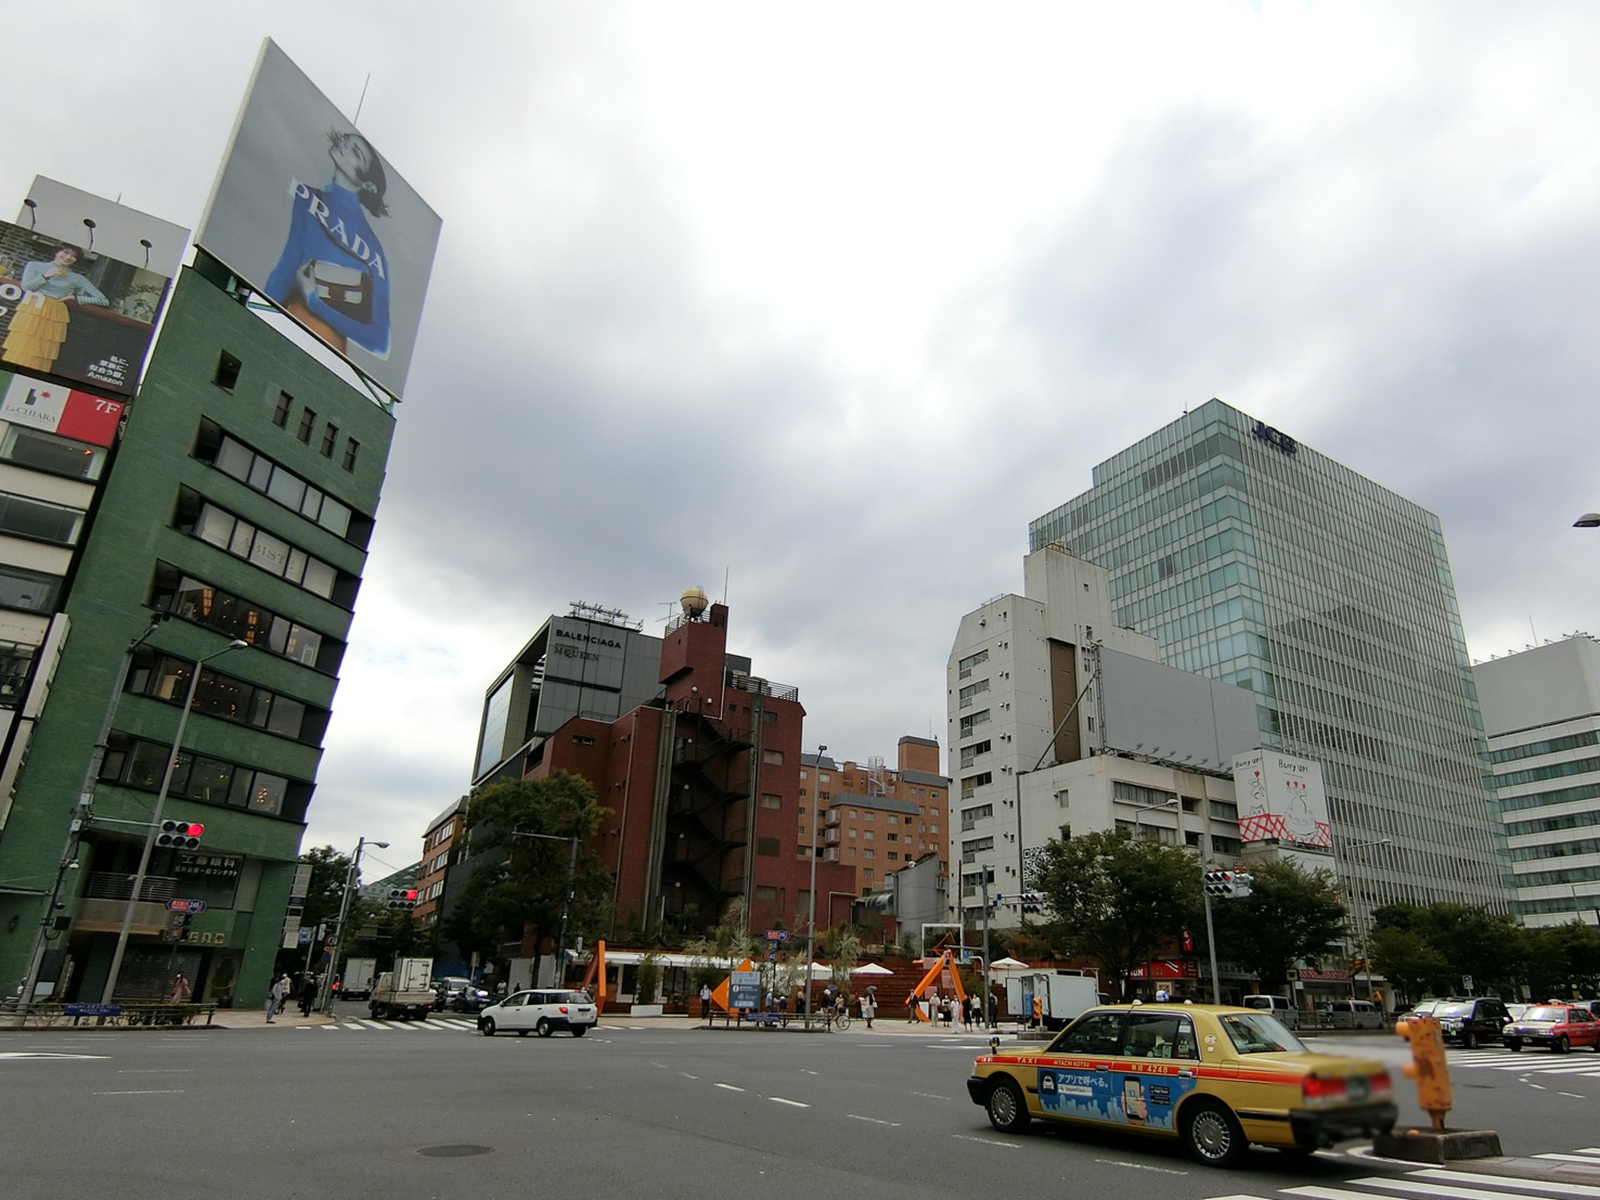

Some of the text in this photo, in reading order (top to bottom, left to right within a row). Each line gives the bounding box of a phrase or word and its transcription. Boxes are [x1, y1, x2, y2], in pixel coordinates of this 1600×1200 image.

[286, 176, 385, 280] PRADA
[87, 371, 124, 387] Amazon
[95, 399, 120, 414] 7F
[1251, 420, 1297, 454] JCB
[556, 629, 622, 649] BALENCIAGA
[1017, 1056, 1037, 1064] TAXI
[1147, 1065, 1168, 1073] 4248
[1057, 1073, 1109, 1088] アプリで呼べる。
